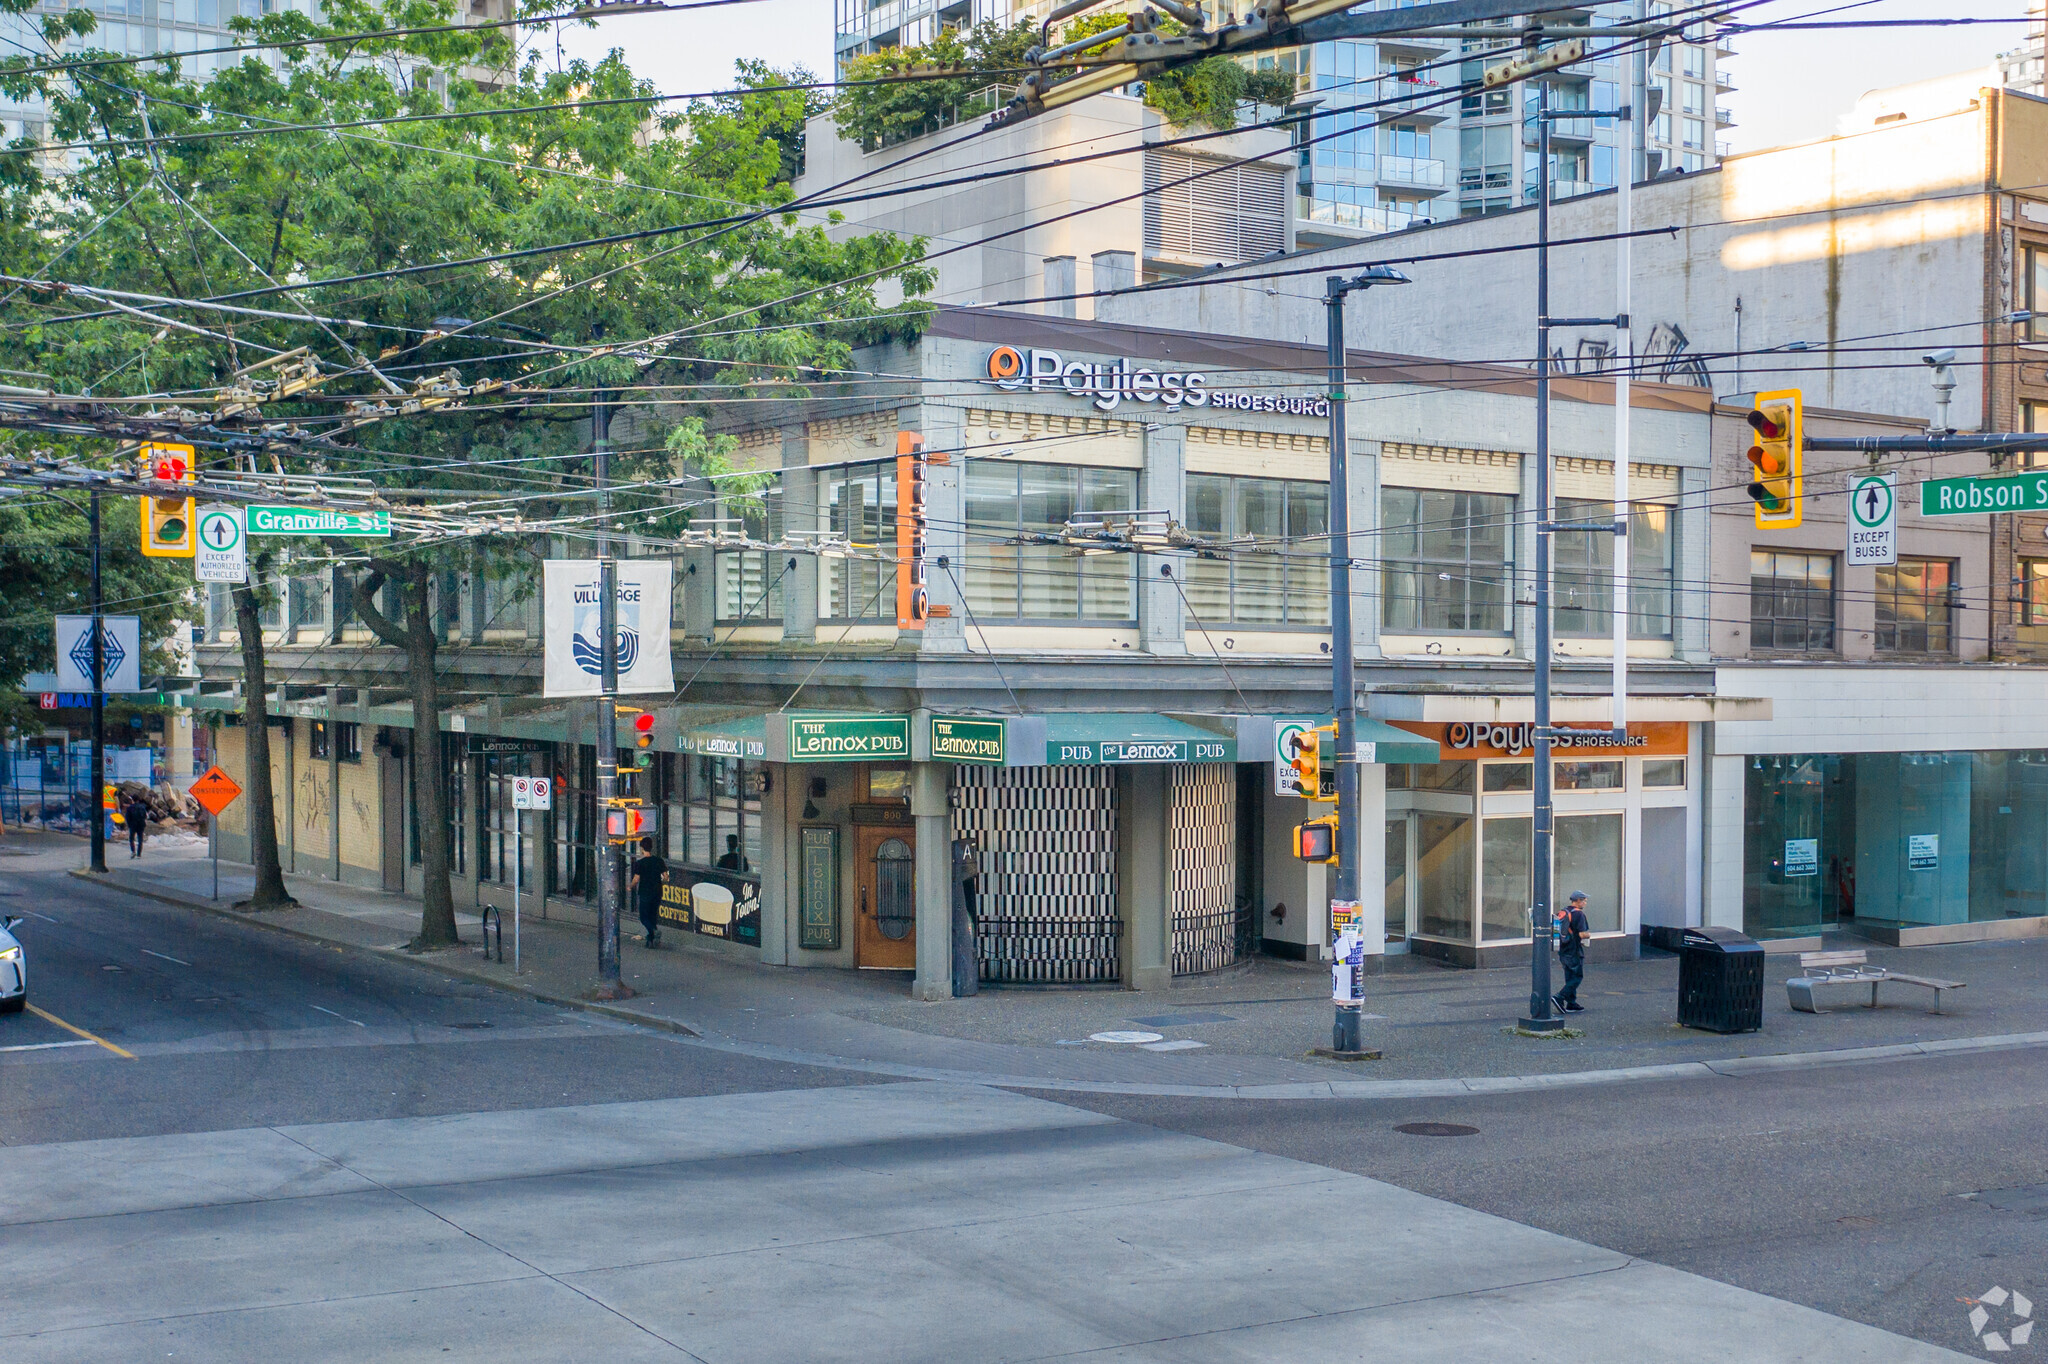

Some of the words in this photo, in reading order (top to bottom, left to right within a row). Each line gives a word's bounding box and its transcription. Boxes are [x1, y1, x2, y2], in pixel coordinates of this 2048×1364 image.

[1031, 349, 1207, 410] Payless
[1212, 392, 1329, 416] SHOESOURC
[1940, 483, 2023, 509] Robson
[2036, 479, 2048, 504] S
[256, 511, 348, 530] Granville
[359, 515, 381, 531] St
[1854, 531, 1889, 543] EXCEPT
[206, 553, 234, 561] EXCEPT
[1855, 546, 1887, 557] BUSES
[201, 562, 241, 570] AUTHORIZED
[203, 571, 239, 579] VEHICLES
[802, 724, 825, 735] THE
[938, 724, 952, 735] THE
[482, 742, 520, 751] Lennox
[679, 736, 695, 750] PUB
[706, 737, 737, 753] Lennox
[747, 741, 764, 755] PUB
[797, 736, 868, 752] Lennox
[871, 736, 903, 751] PUB
[935, 736, 977, 754] Lennox
[978, 740, 999, 756] PUB
[1061, 746, 1092, 760] PUB
[1104, 745, 1117, 755] the
[1118, 743, 1177, 759] Lennox
[1196, 743, 1225, 758] PUB
[1280, 768, 1299, 777] EXCE
[807, 833, 830, 844] PUB
[662, 884, 690, 906] RISH
[659, 905, 689, 923] COFFEE
[807, 928, 830, 939] PUB
